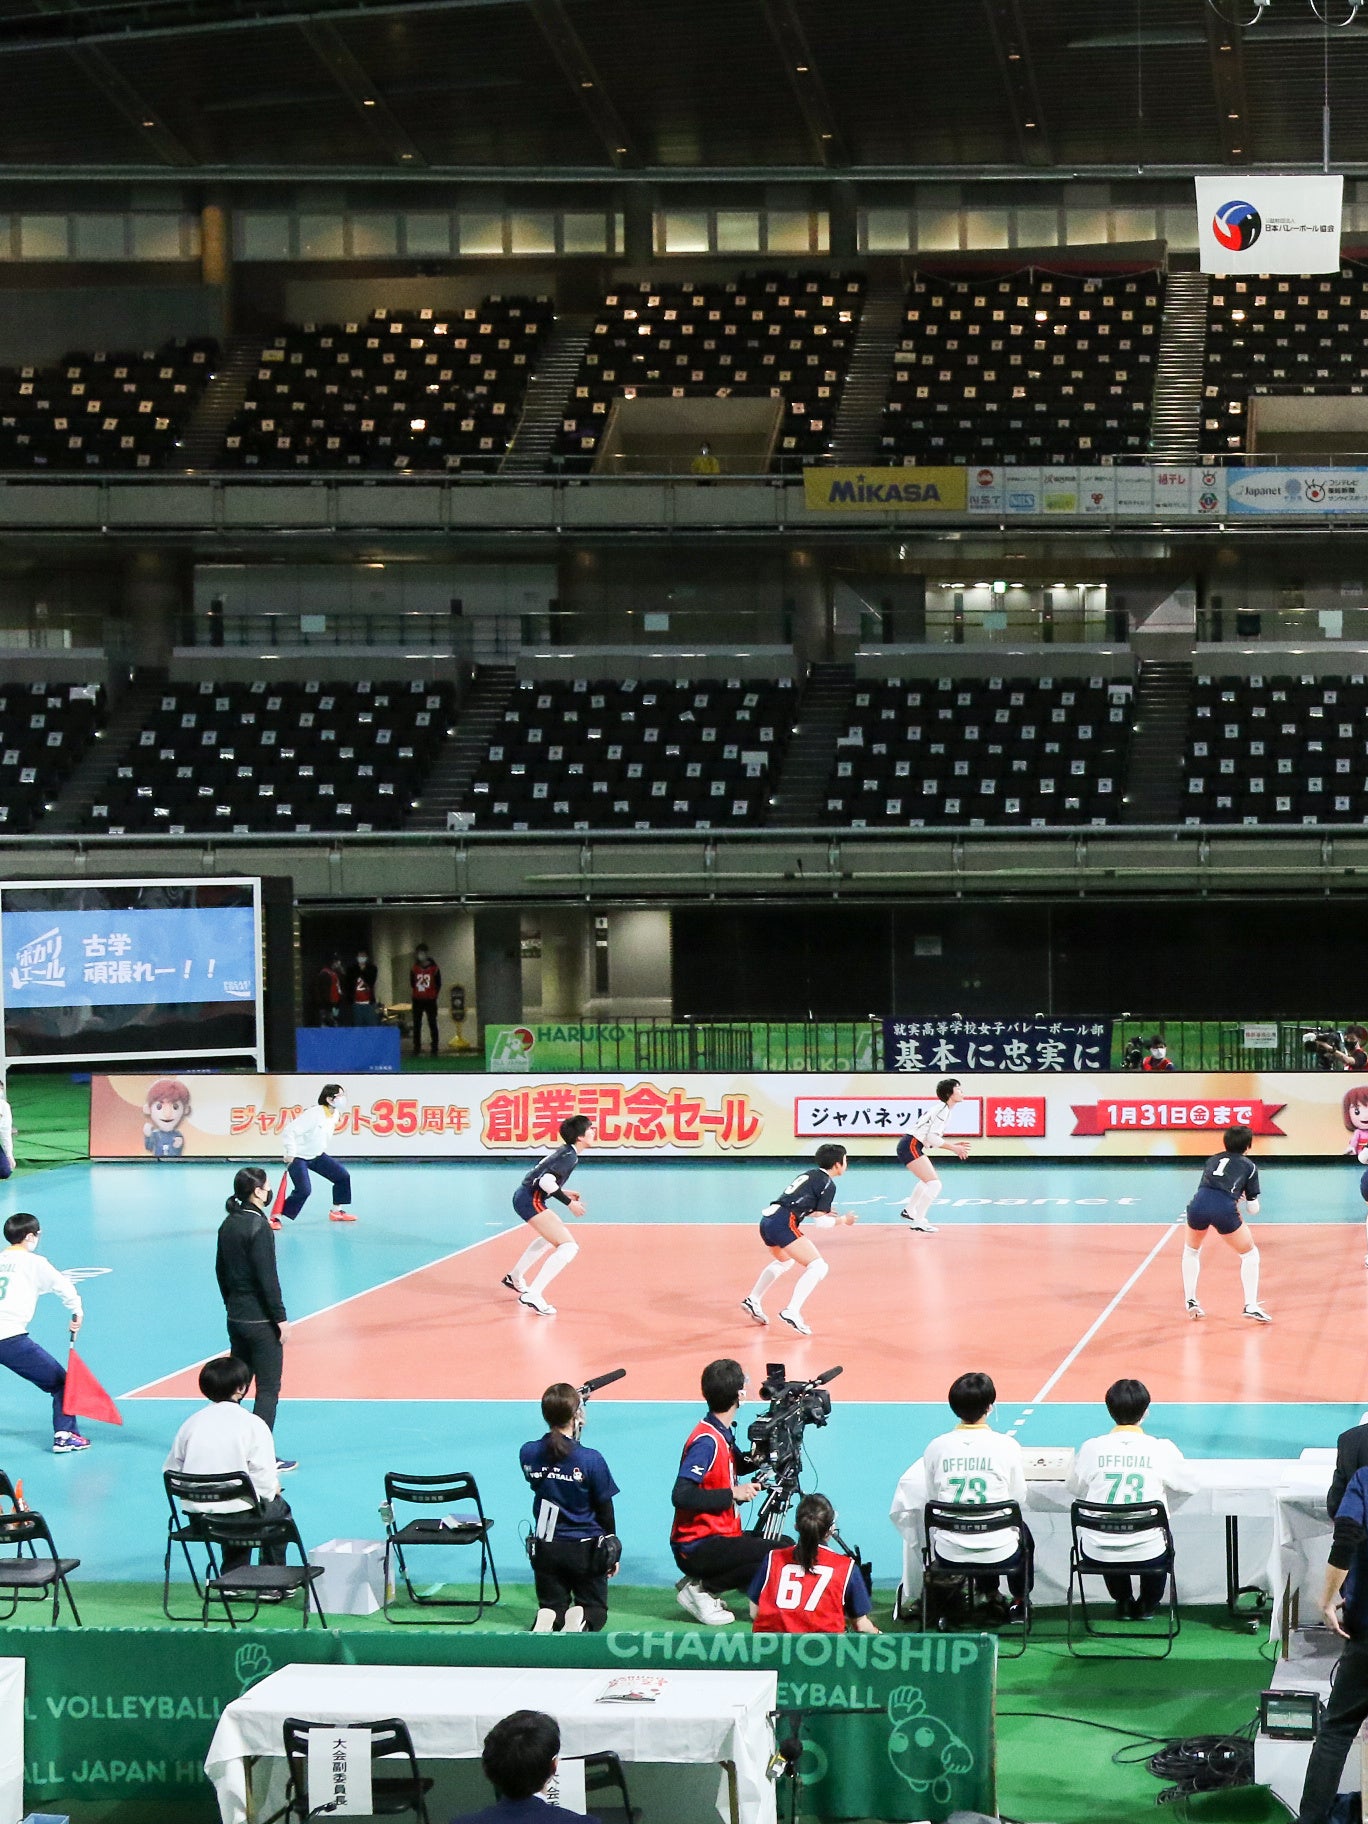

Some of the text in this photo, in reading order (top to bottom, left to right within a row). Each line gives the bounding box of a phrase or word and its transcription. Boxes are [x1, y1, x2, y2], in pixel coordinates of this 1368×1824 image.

[1265, 224, 1335, 233] 日本バレーボール協会
[1244, 486, 1281, 497] Japanet
[82, 933, 132, 957] 古学
[537, 1026, 626, 1042] HARUKO
[893, 1020, 1105, 1037] 就実高等学校女子バレーボール部
[893, 1038, 1101, 1072] 基本に忠実に
[229, 1085, 761, 1145] ジャパット35周年 創業記念セール
[994, 1106, 1037, 1128] 検索
[1212, 1157, 1230, 1177] 1
[942, 1456, 995, 1474] OFFICIAL
[1097, 1455, 1153, 1469] OFFICIAL
[948, 1477, 987, 1504] 73
[1104, 1473, 1145, 1504] 73
[775, 1563, 835, 1612] 67
[607, 1632, 978, 1674] CHAMPIONSHIP
[72, 1759, 166, 1784] JAPAN
[331, 1737, 348, 1807] 大会副委員長
